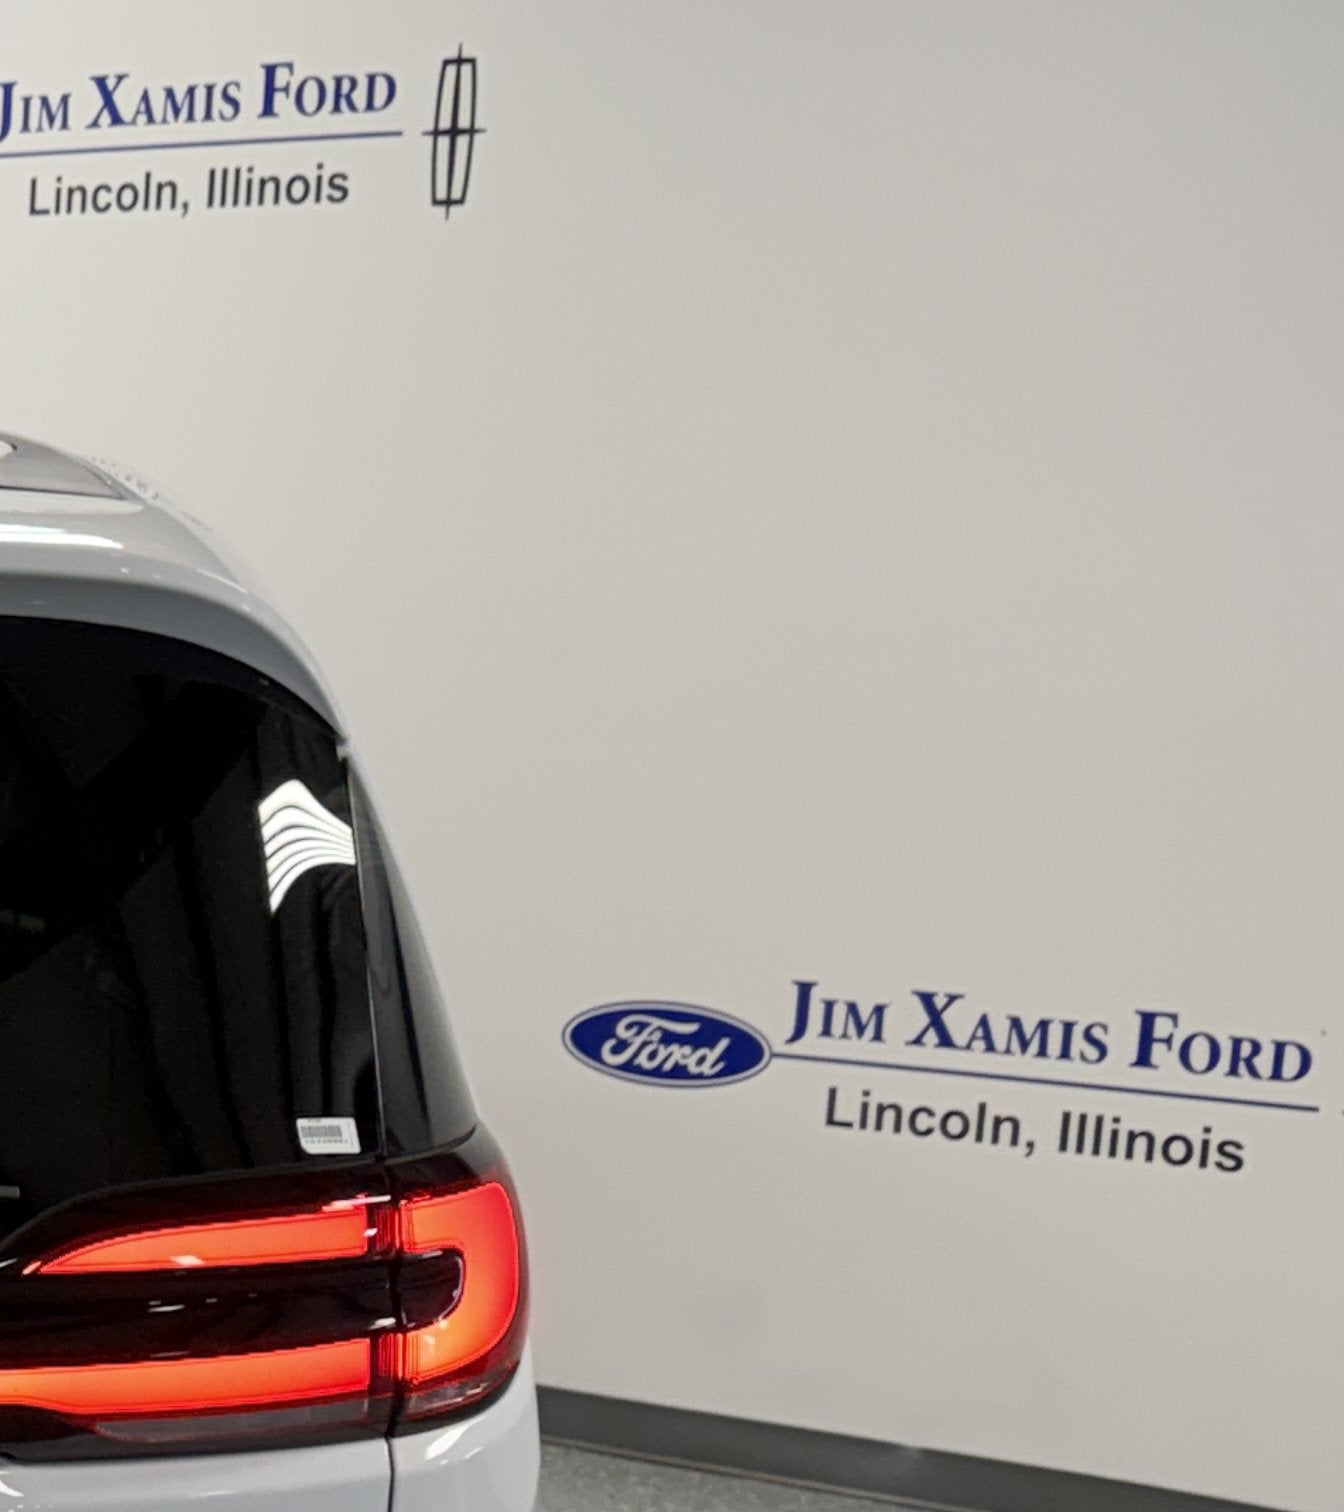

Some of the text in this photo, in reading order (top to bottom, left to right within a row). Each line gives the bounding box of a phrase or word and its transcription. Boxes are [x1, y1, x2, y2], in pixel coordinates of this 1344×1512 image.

[86, 73, 243, 130] XAMIS
[257, 61, 398, 120] FORD
[28, 163, 350, 218] Lincoln, Illinois
[601, 1014, 724, 1078] Ford
[785, 980, 1313, 1085] JIM XAMIS FORD
[825, 1086, 1246, 1172] Lincoln, Illinois
